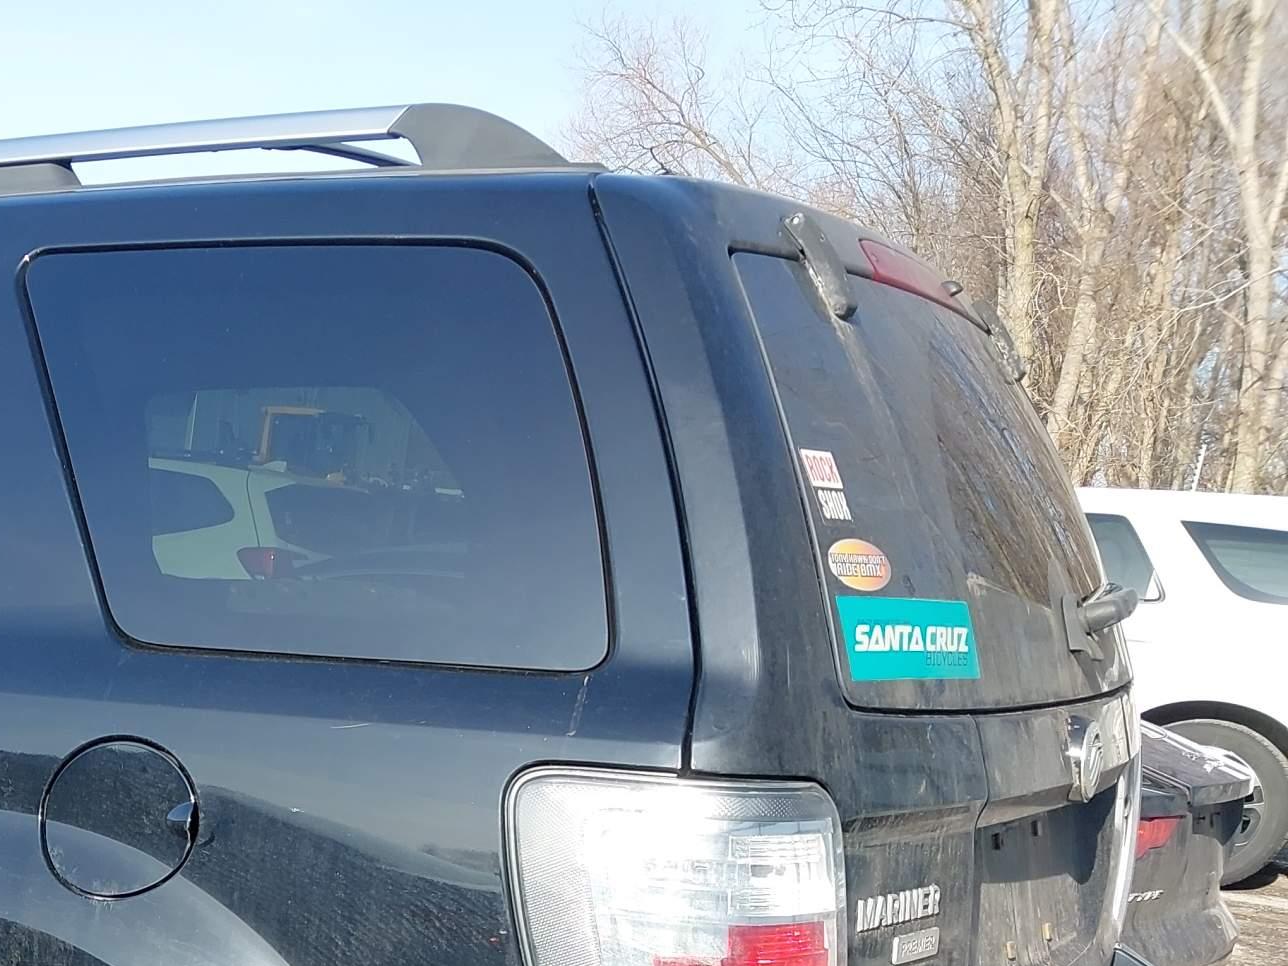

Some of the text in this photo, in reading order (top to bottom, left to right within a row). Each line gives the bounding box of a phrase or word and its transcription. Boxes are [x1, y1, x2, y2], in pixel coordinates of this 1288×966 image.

[804, 454, 840, 483] ROCK
[854, 624, 969, 653] SANTA CRUZ
[925, 652, 968, 667] BICYCLES
[856, 884, 941, 933] MARINER
[901, 935, 936, 958] PREMIER
